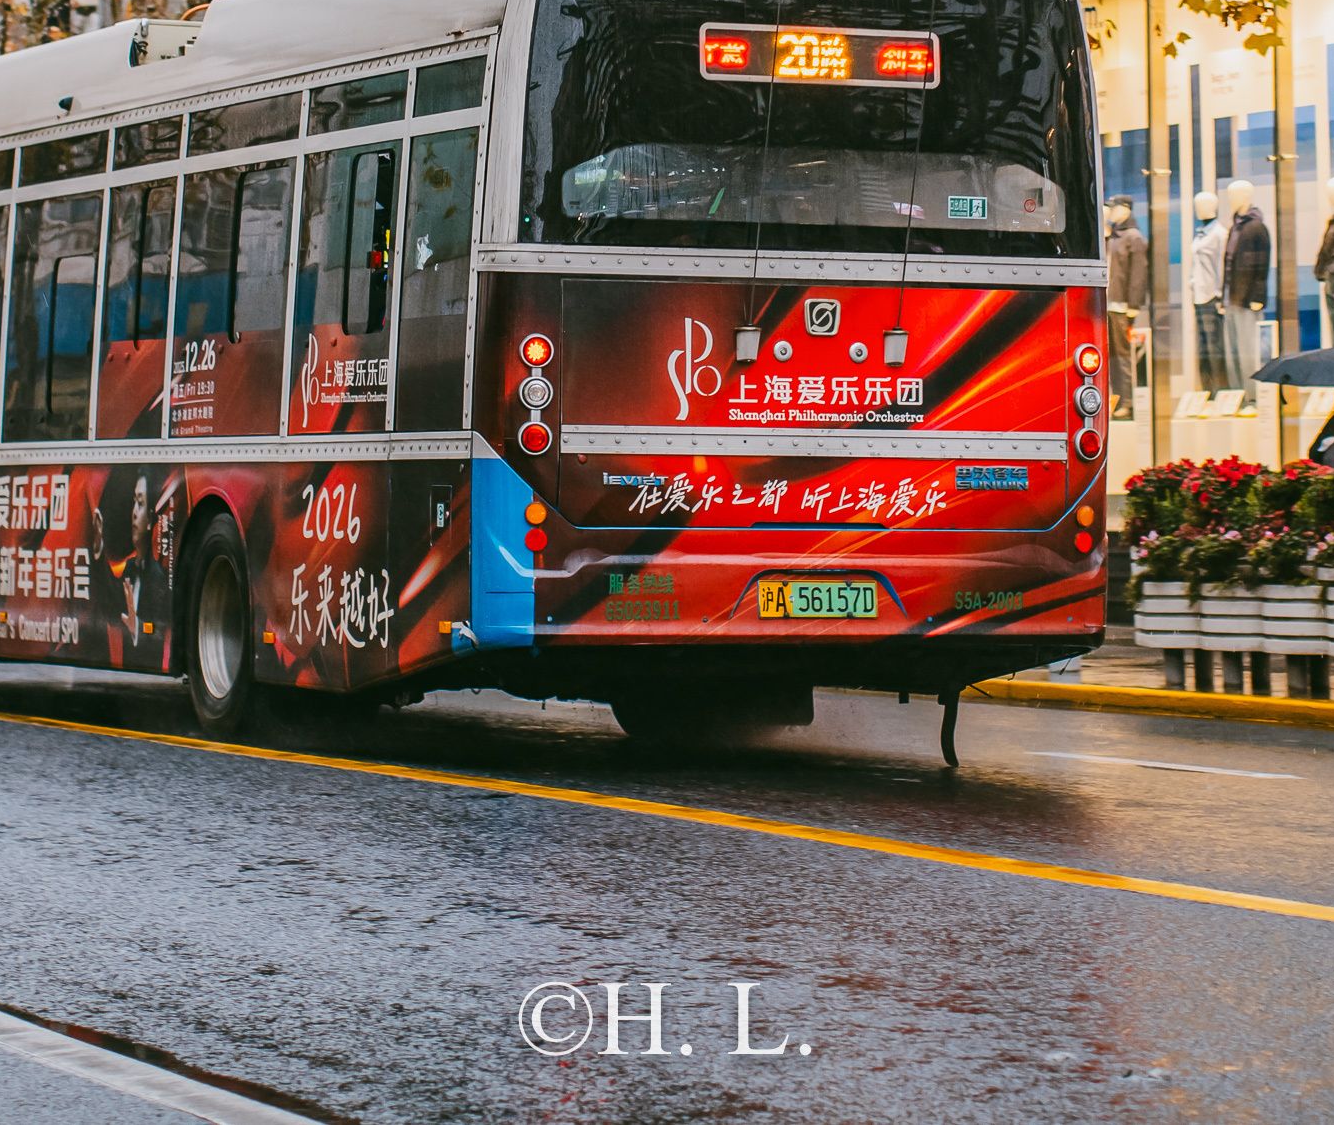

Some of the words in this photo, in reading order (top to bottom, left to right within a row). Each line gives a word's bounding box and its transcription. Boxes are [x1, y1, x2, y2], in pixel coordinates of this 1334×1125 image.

[321, 359, 388, 387] 上海爱乐乐团
[728, 375, 923, 406] 上海爱乐乐团
[728, 409, 786, 424] Shanghai
[788, 409, 864, 422] Philharmonic
[865, 410, 924, 423] Orchestra
[955, 466, 1028, 479] 申沃客车
[955, 480, 1029, 490] SUNWIN
[629, 473, 788, 515] 在爱乐之都
[801, 478, 947, 521] 听上海爱乐
[302, 483, 361, 544] 2026
[609, 574, 674, 595] 服务热线
[289, 563, 395, 649] 乐来越好
[606, 600, 680, 621] 65023911
[798, 586, 875, 613] 56157D
[955, 591, 1024, 610] S5A-2003
[61, 616, 78, 644] SPO
